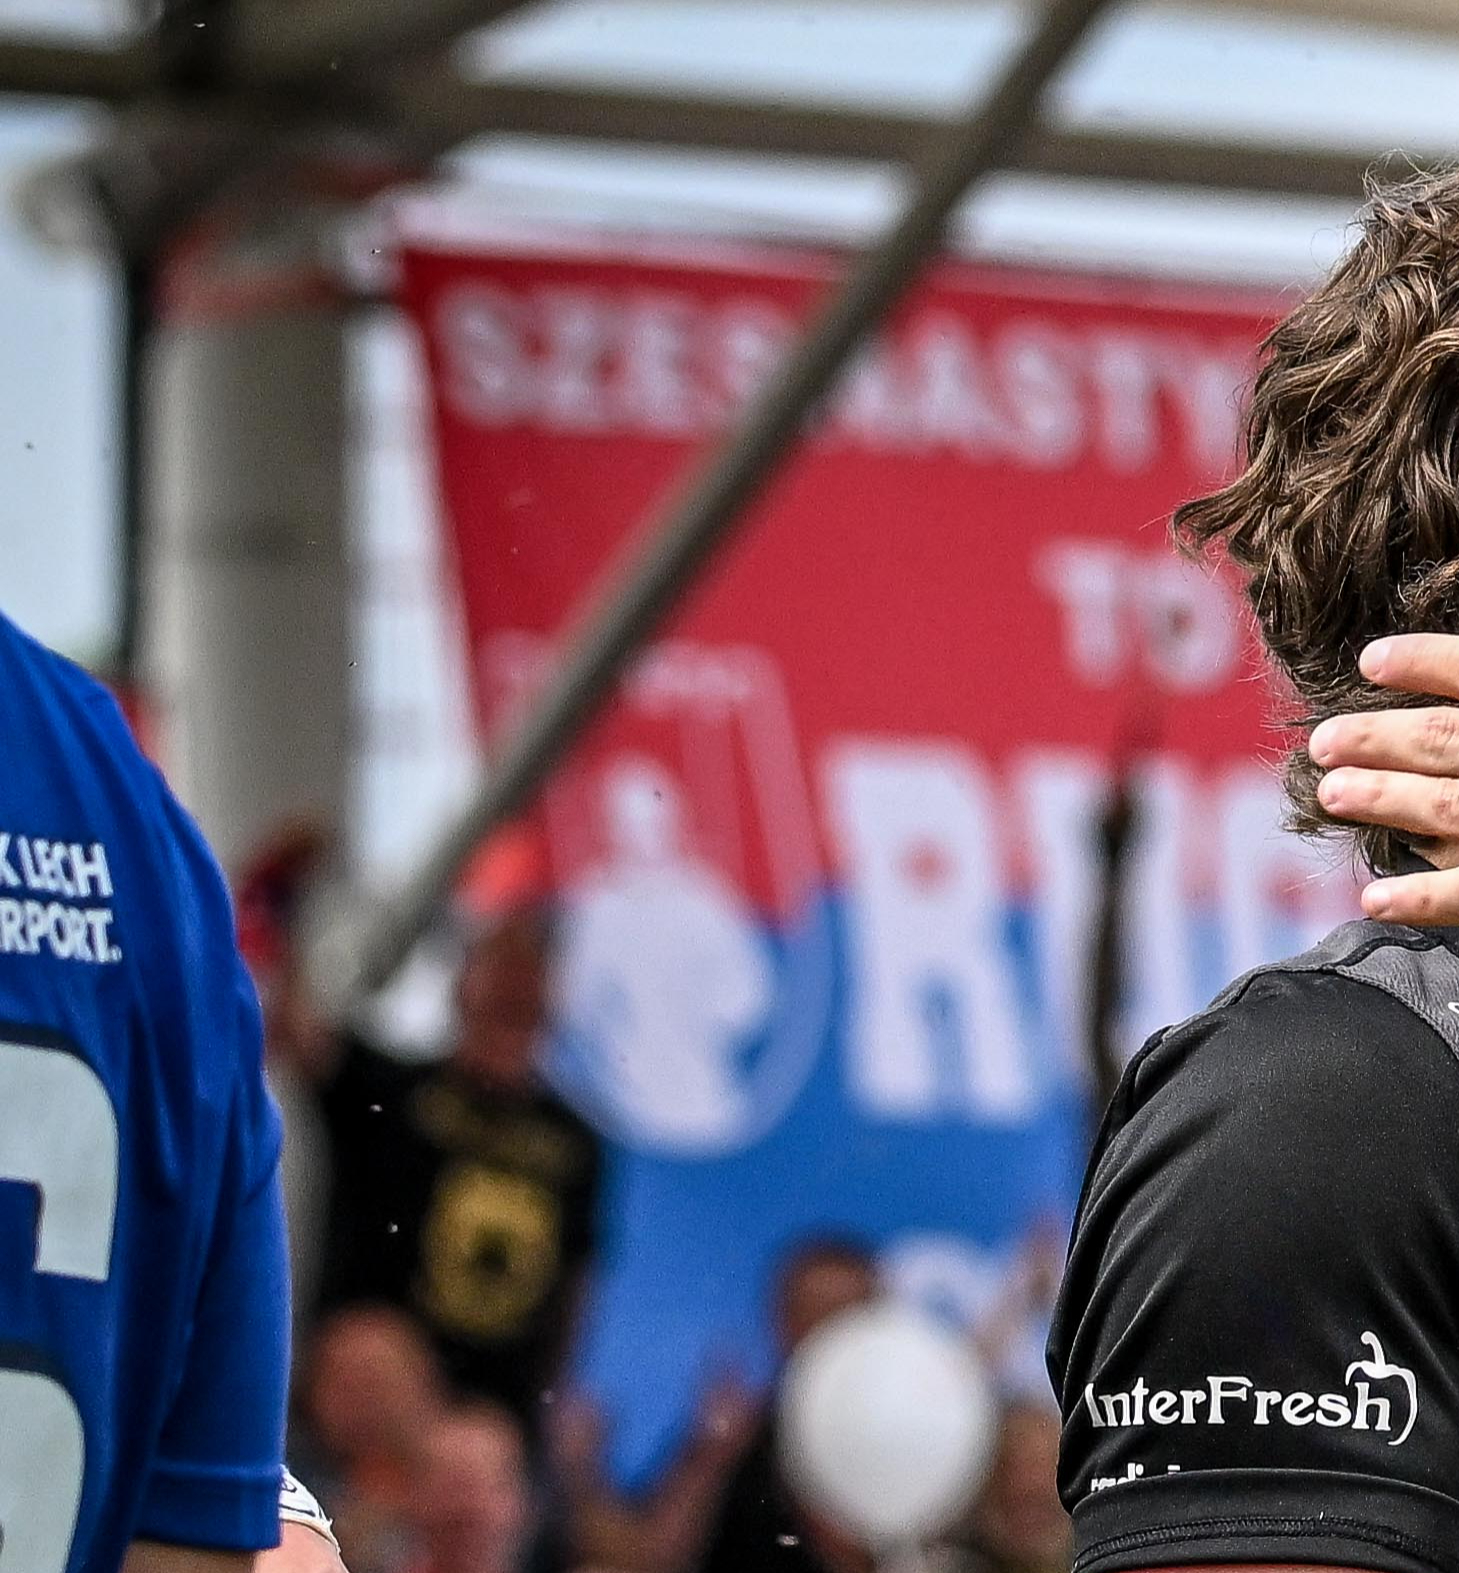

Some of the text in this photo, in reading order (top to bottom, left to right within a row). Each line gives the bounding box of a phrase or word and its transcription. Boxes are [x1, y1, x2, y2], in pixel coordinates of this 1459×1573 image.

[17, 836, 114, 898] LECH
[0, 897, 122, 962] RPORT.
[1084, 1376, 1392, 1431] InterFresh
